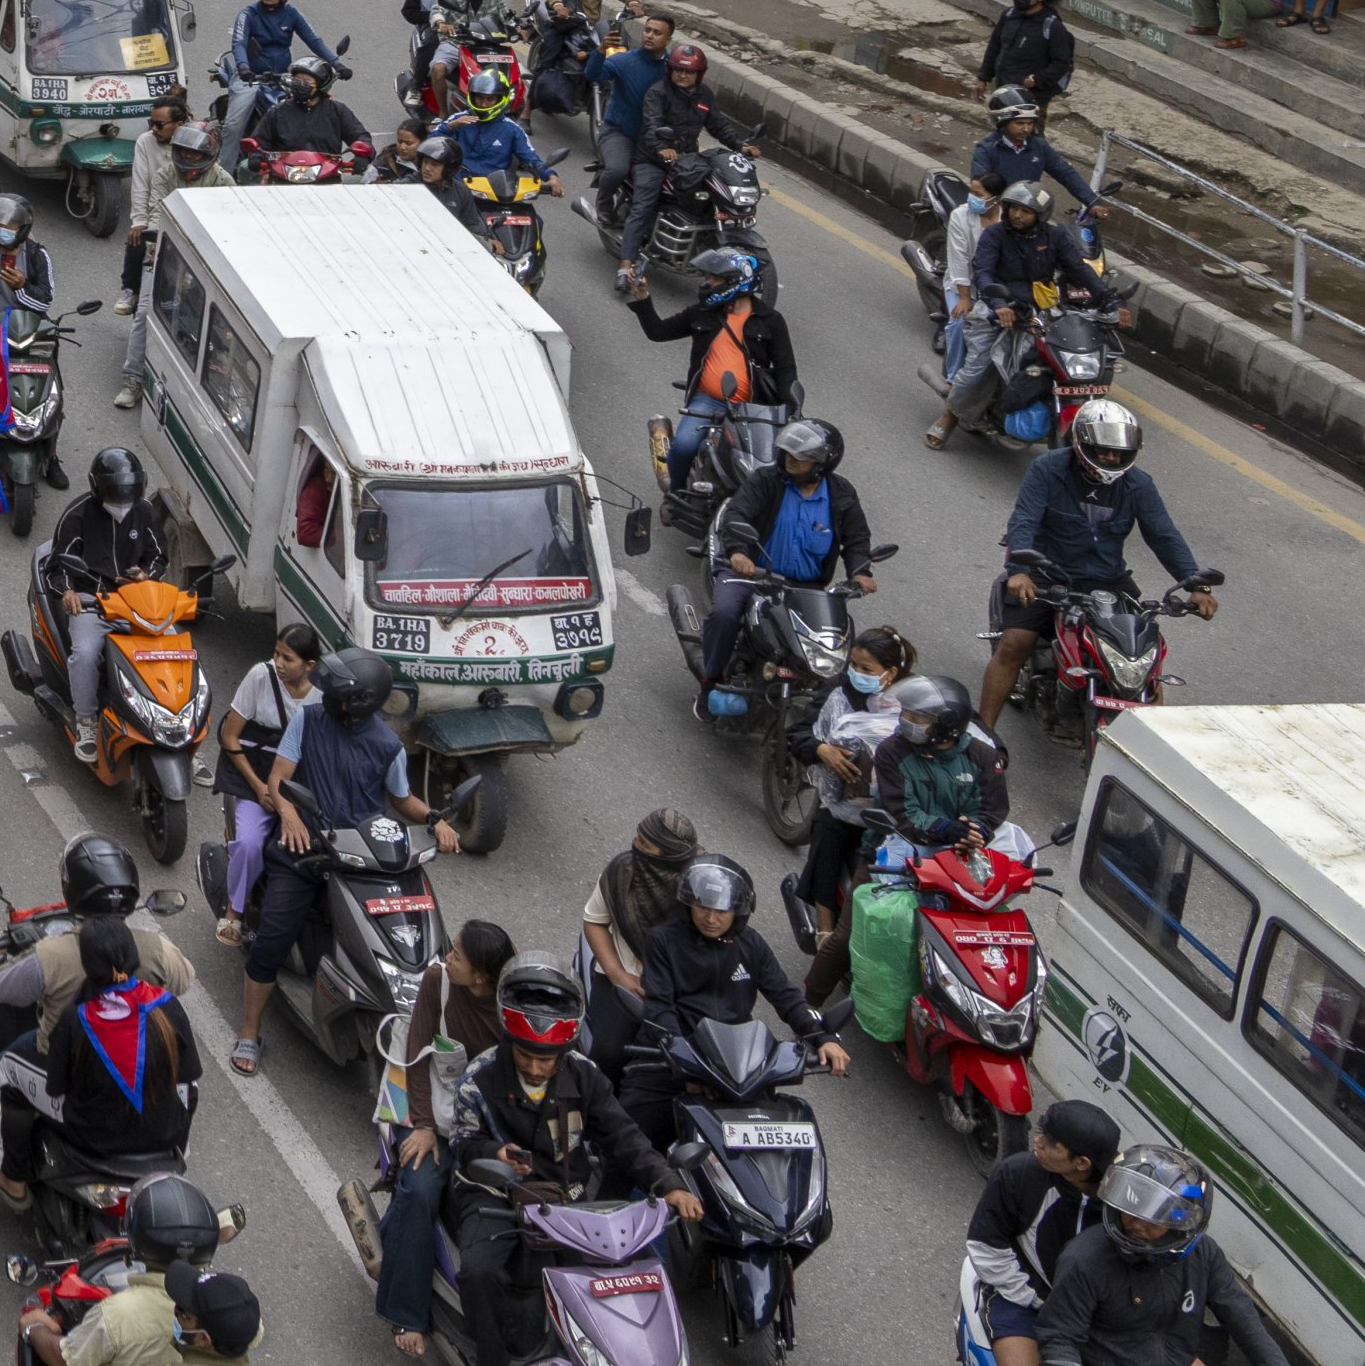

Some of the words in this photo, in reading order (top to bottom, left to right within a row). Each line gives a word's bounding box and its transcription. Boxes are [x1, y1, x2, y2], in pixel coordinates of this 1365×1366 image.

[32, 88, 68, 101] 3940
[581, 613, 594, 626] ह
[375, 631, 426, 654] 3719
[555, 627, 601, 649] ३७१९
[1106, 994, 1133, 1024] सफा
[1092, 1076, 1112, 1094] EV
[742, 1134, 751, 1145] A
